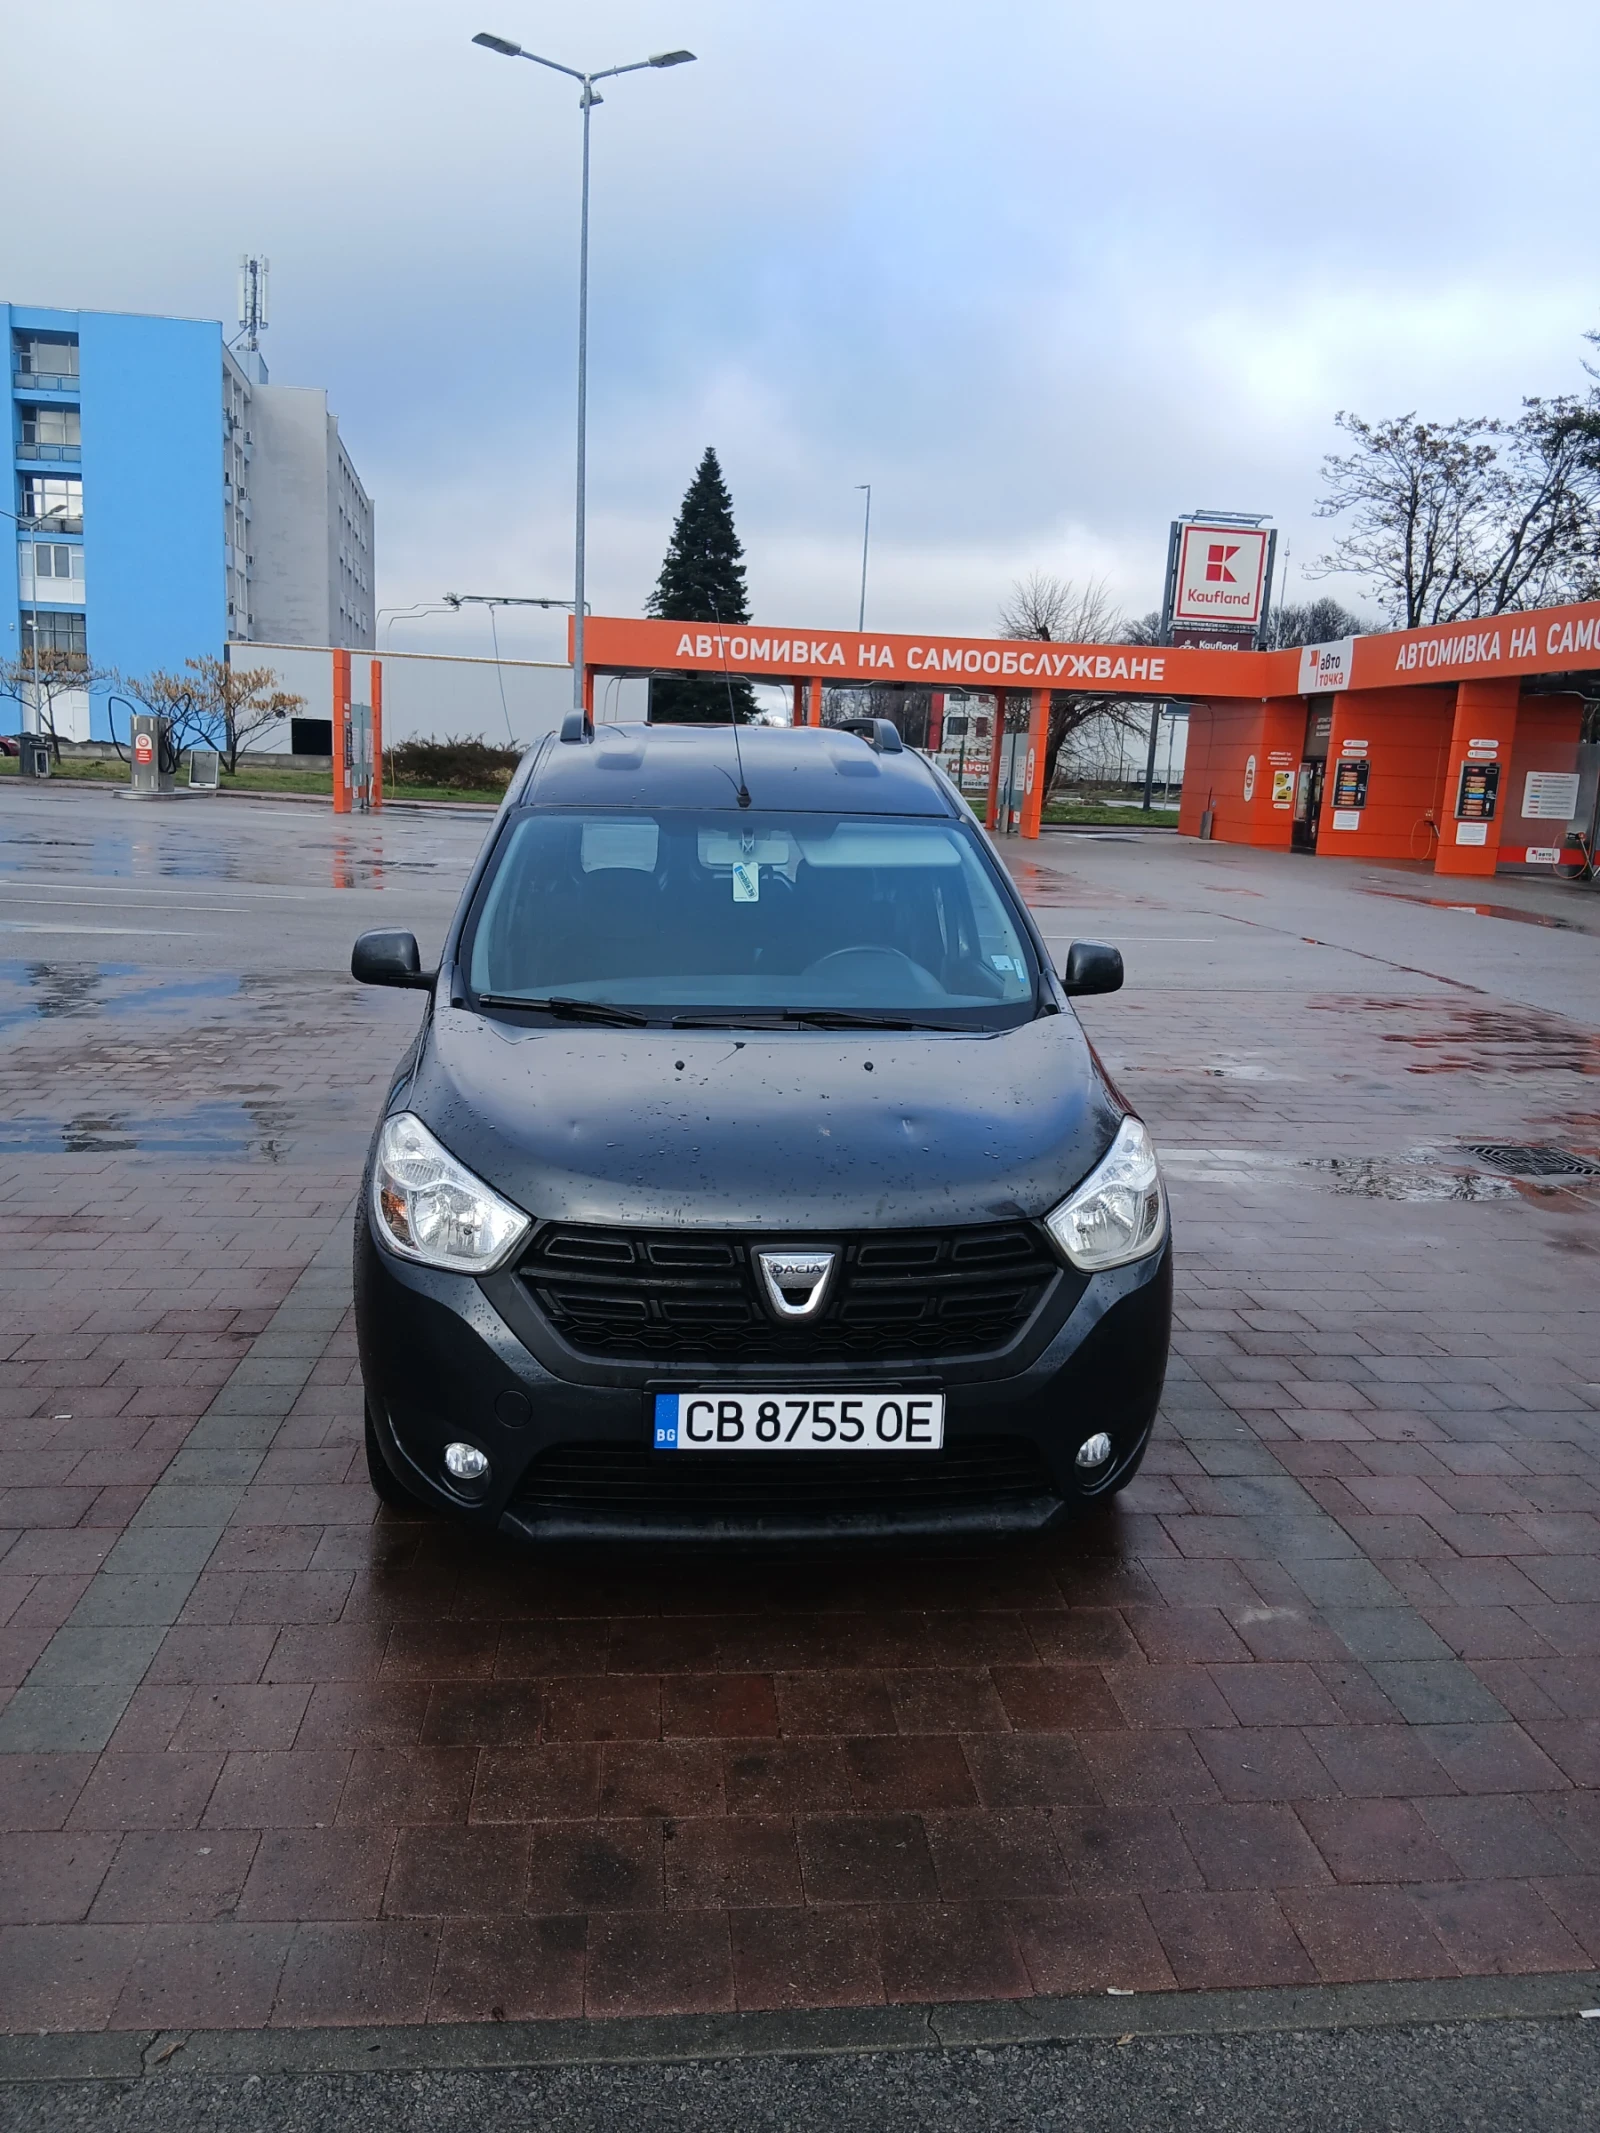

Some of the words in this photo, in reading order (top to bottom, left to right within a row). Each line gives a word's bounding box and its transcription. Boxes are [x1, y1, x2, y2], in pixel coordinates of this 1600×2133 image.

[1187, 588, 1250, 606] Kaufland
[1199, 640, 1239, 651] Kaufland
[1395, 630, 1500, 671] АВТОМИВКА
[1509, 625, 1537, 659] НА
[676, 633, 846, 666] АВТОМИВКА
[858, 644, 895, 669] НА
[906, 647, 1166, 682] САМООБСЛУЖВАНЕ
[1320, 653, 1341, 671] авто
[1319, 671, 1344, 687] точка
[772, 1265, 823, 1274] DACIA
[685, 1400, 745, 1443] CB
[755, 1400, 865, 1443] 8755
[876, 1401, 933, 1443] OE
[656, 1429, 676, 1442] BG
